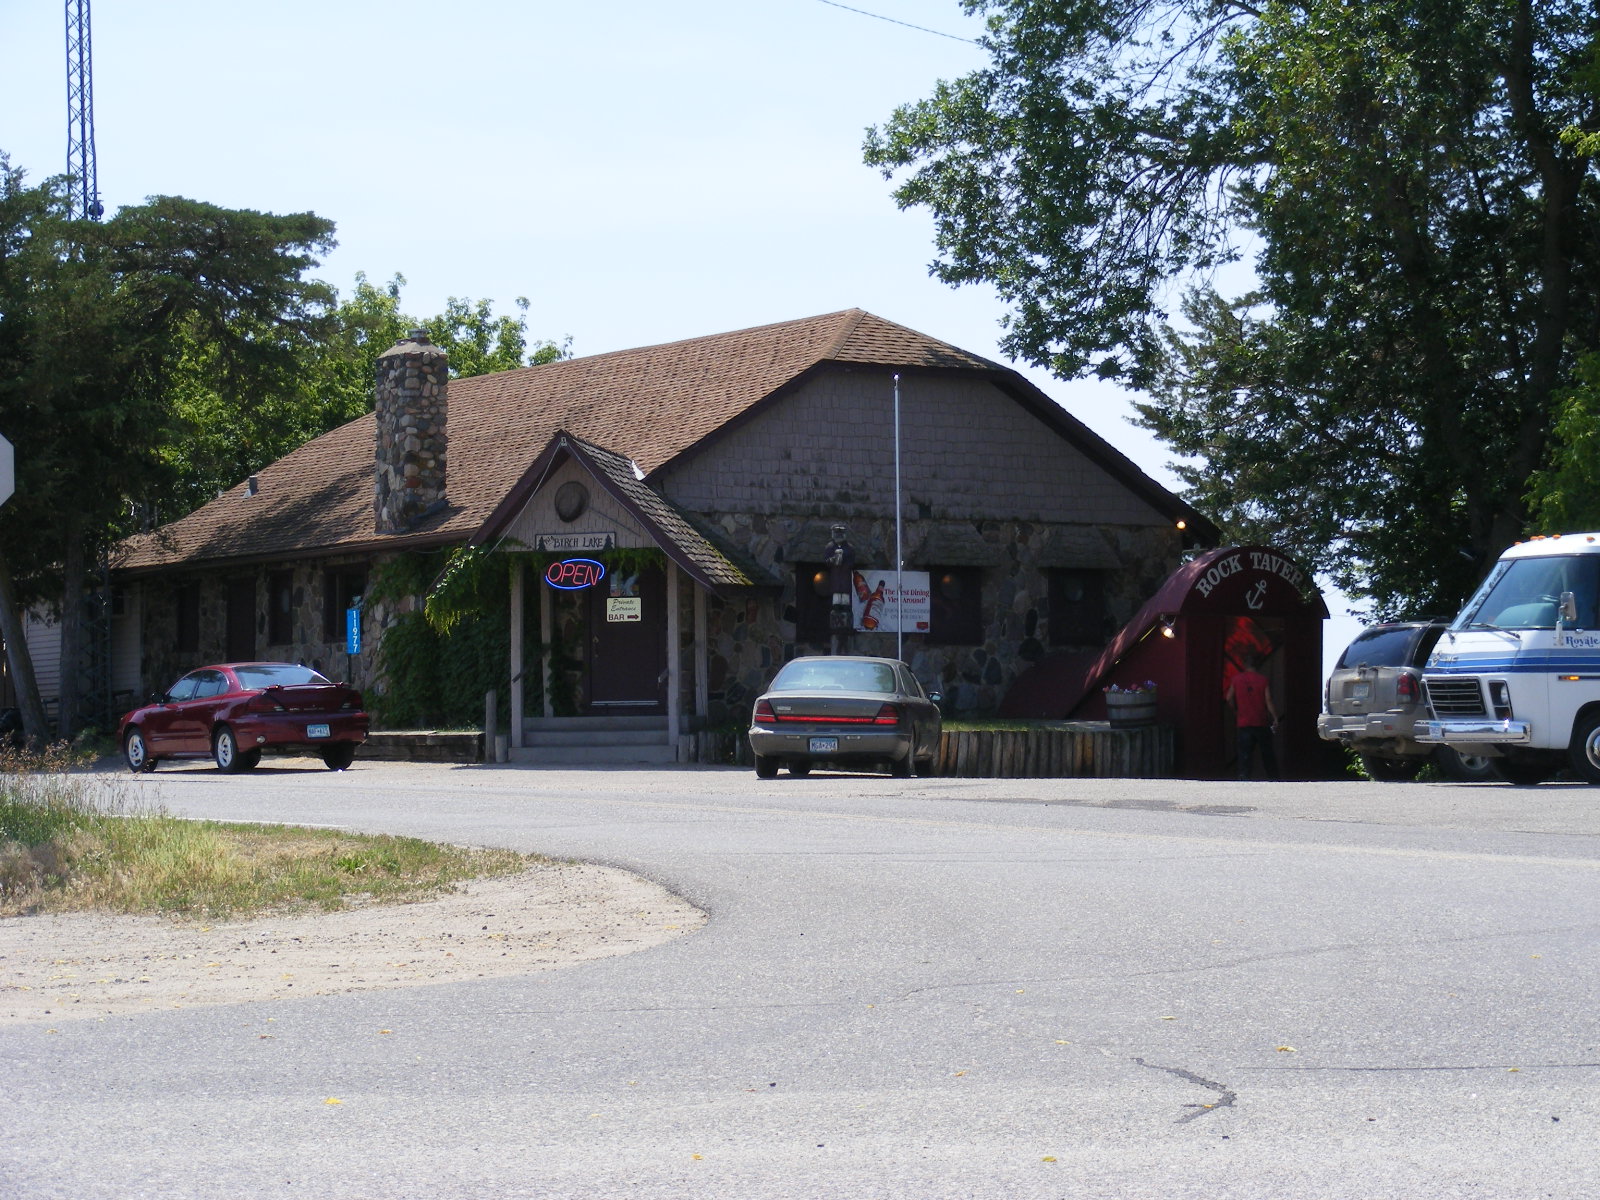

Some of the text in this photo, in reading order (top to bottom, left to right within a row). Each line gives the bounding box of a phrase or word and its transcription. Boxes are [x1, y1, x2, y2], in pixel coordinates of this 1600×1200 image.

[554, 537, 578, 548] BIRCH
[583, 537, 603, 548] LAKE
[548, 562, 600, 586] OPEN
[1196, 552, 1304, 598] ROCK TAVER
[910, 588, 930, 598] Dining
[1566, 636, 1599, 648] Royale
